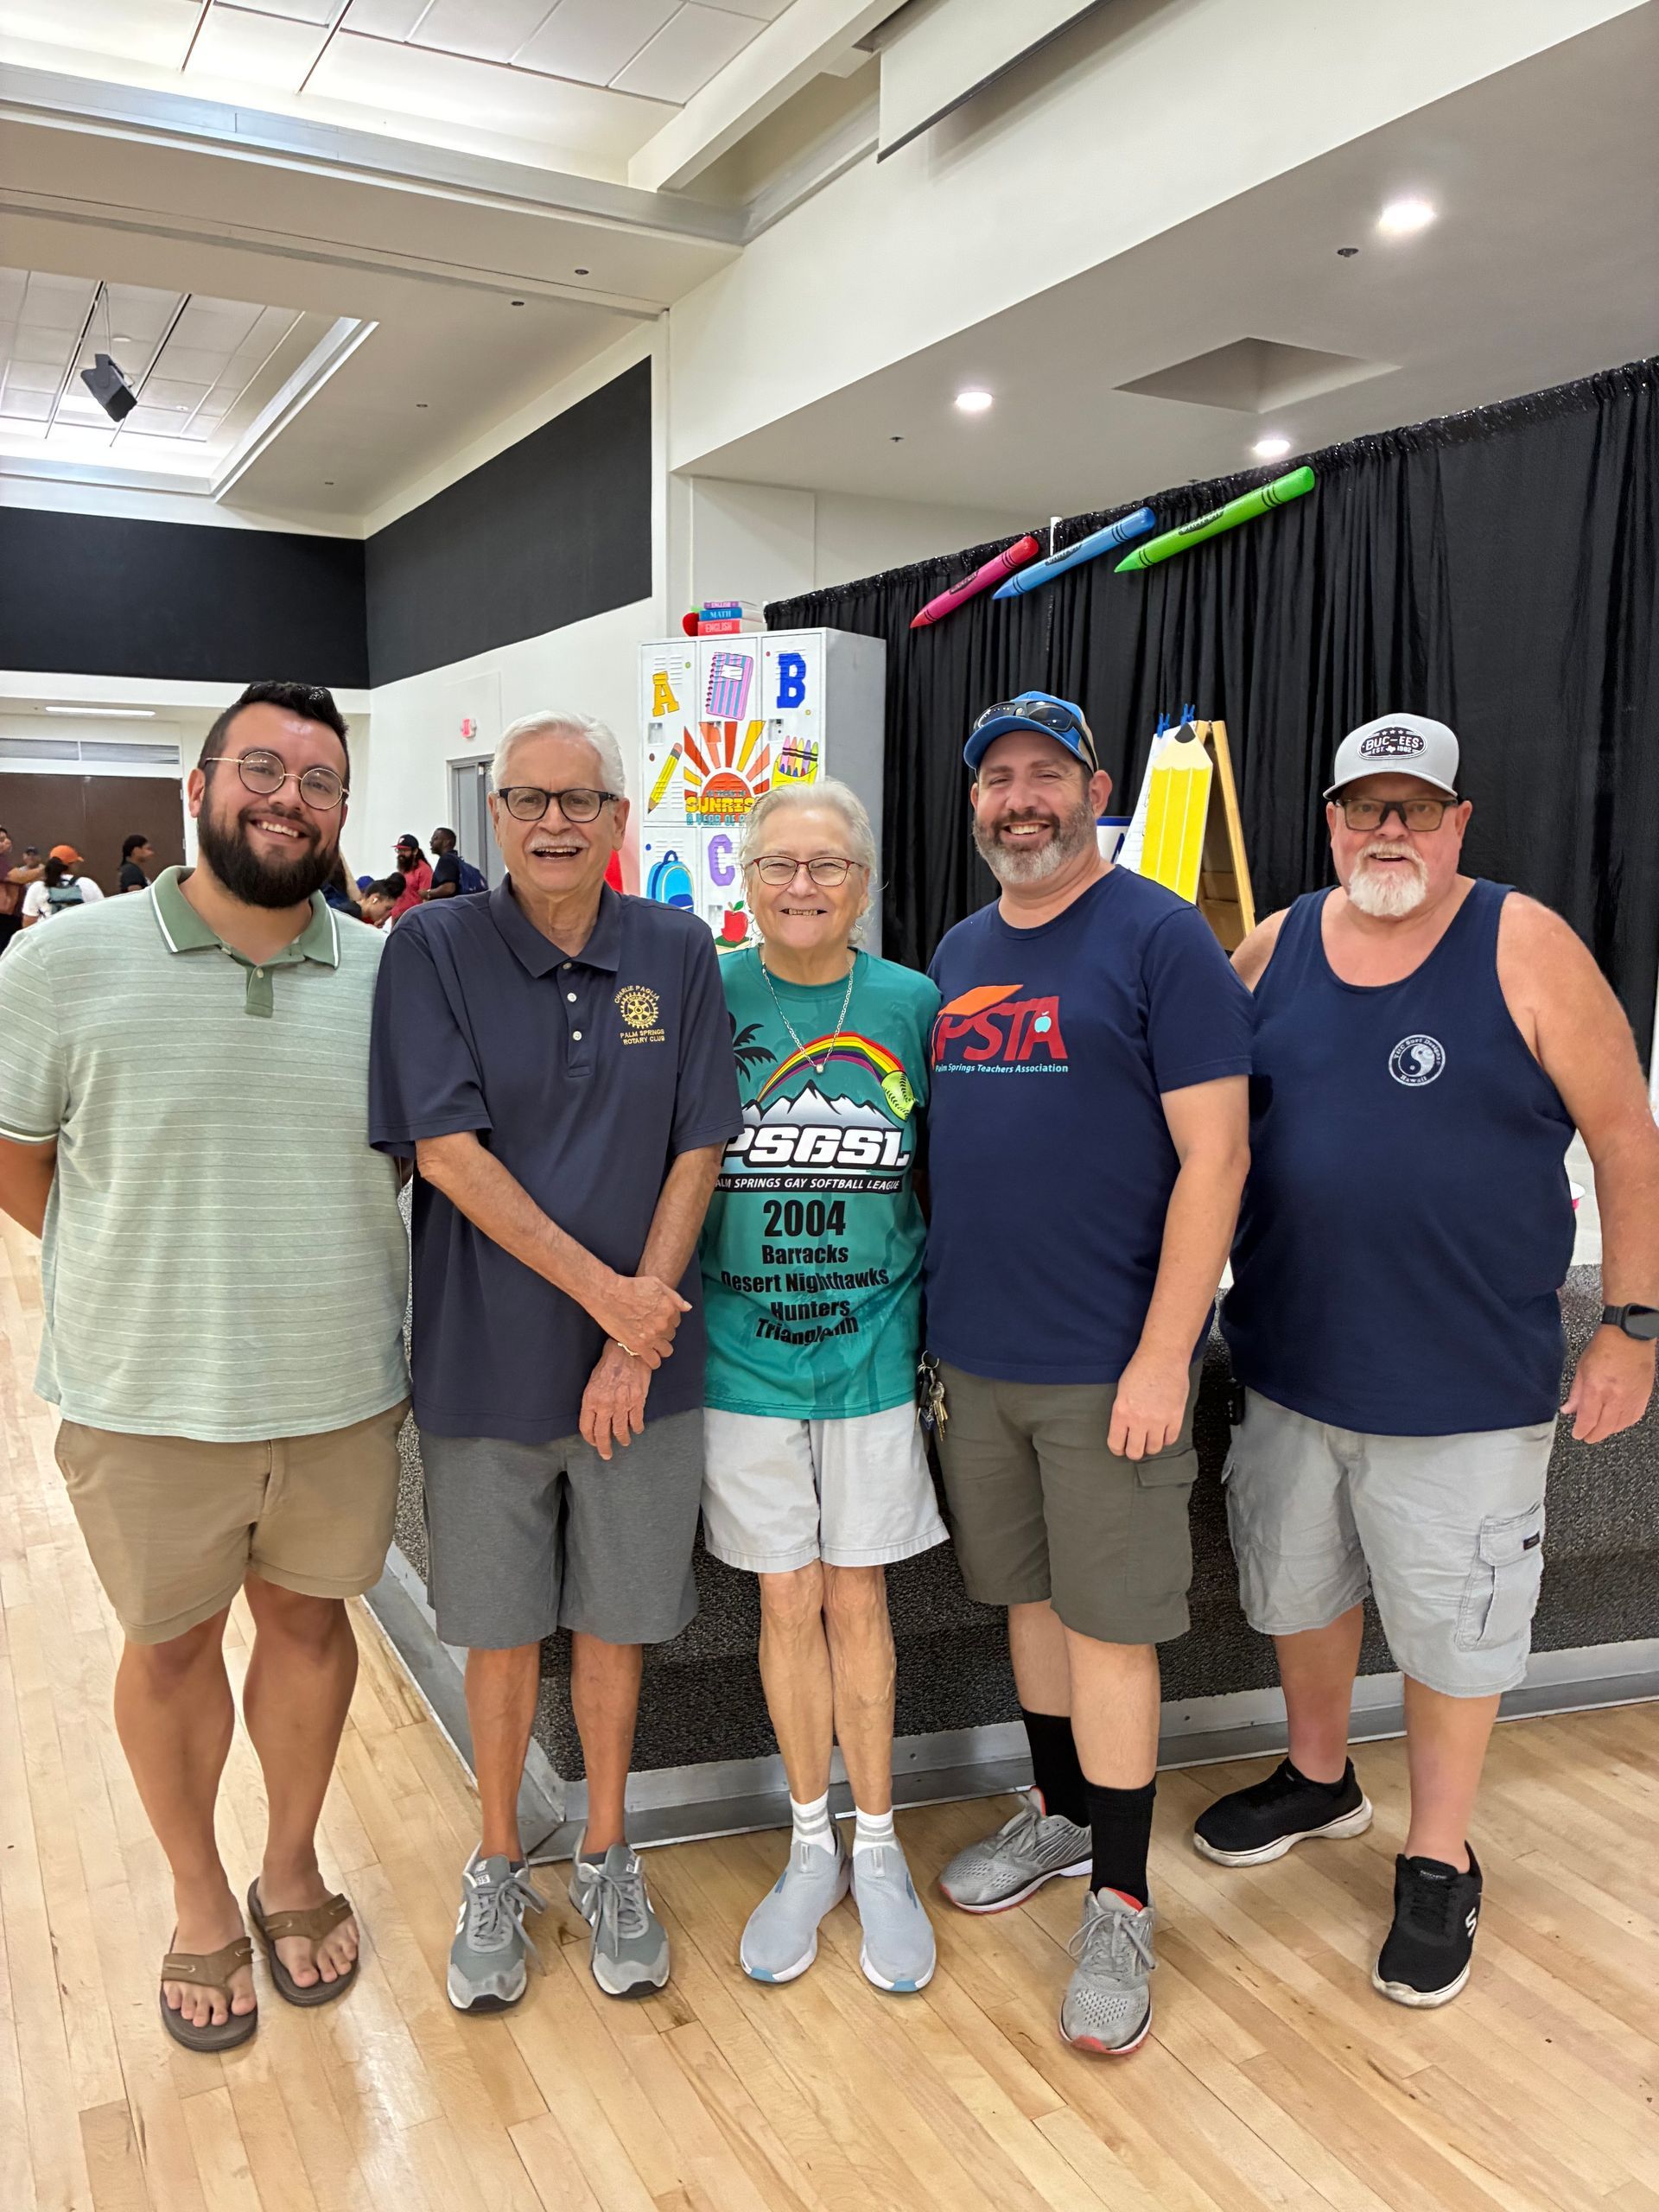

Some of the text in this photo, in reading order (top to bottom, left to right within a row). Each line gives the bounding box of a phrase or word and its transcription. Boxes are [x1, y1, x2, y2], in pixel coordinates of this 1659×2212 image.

[709, 610, 732, 619] MATH
[704, 621, 733, 633] ENGLISH
[776, 652, 806, 709] B
[652, 671, 680, 717] A
[1365, 735, 1420, 751] BUC-EES
[685, 796, 755, 814] SUNRIS
[708, 834, 735, 887] C
[614, 985, 635, 1003] CHARLIE
[936, 995, 1068, 1061] PSTA
[623, 1036, 648, 1046] ROTARY
[935, 1063, 1069, 1074] Palm Springs Teachers Association
[1400, 1074, 1427, 1083] Hawaii
[715, 1177, 900, 1191] ALM SPRINGS GAY SOFTBALL LEAGUE
[762, 1198, 847, 1237] 2004
[761, 1244, 849, 1265] Barracks
[721, 1267, 890, 1294] Desert Nighthawks
[770, 1299, 851, 1322] Hunters
